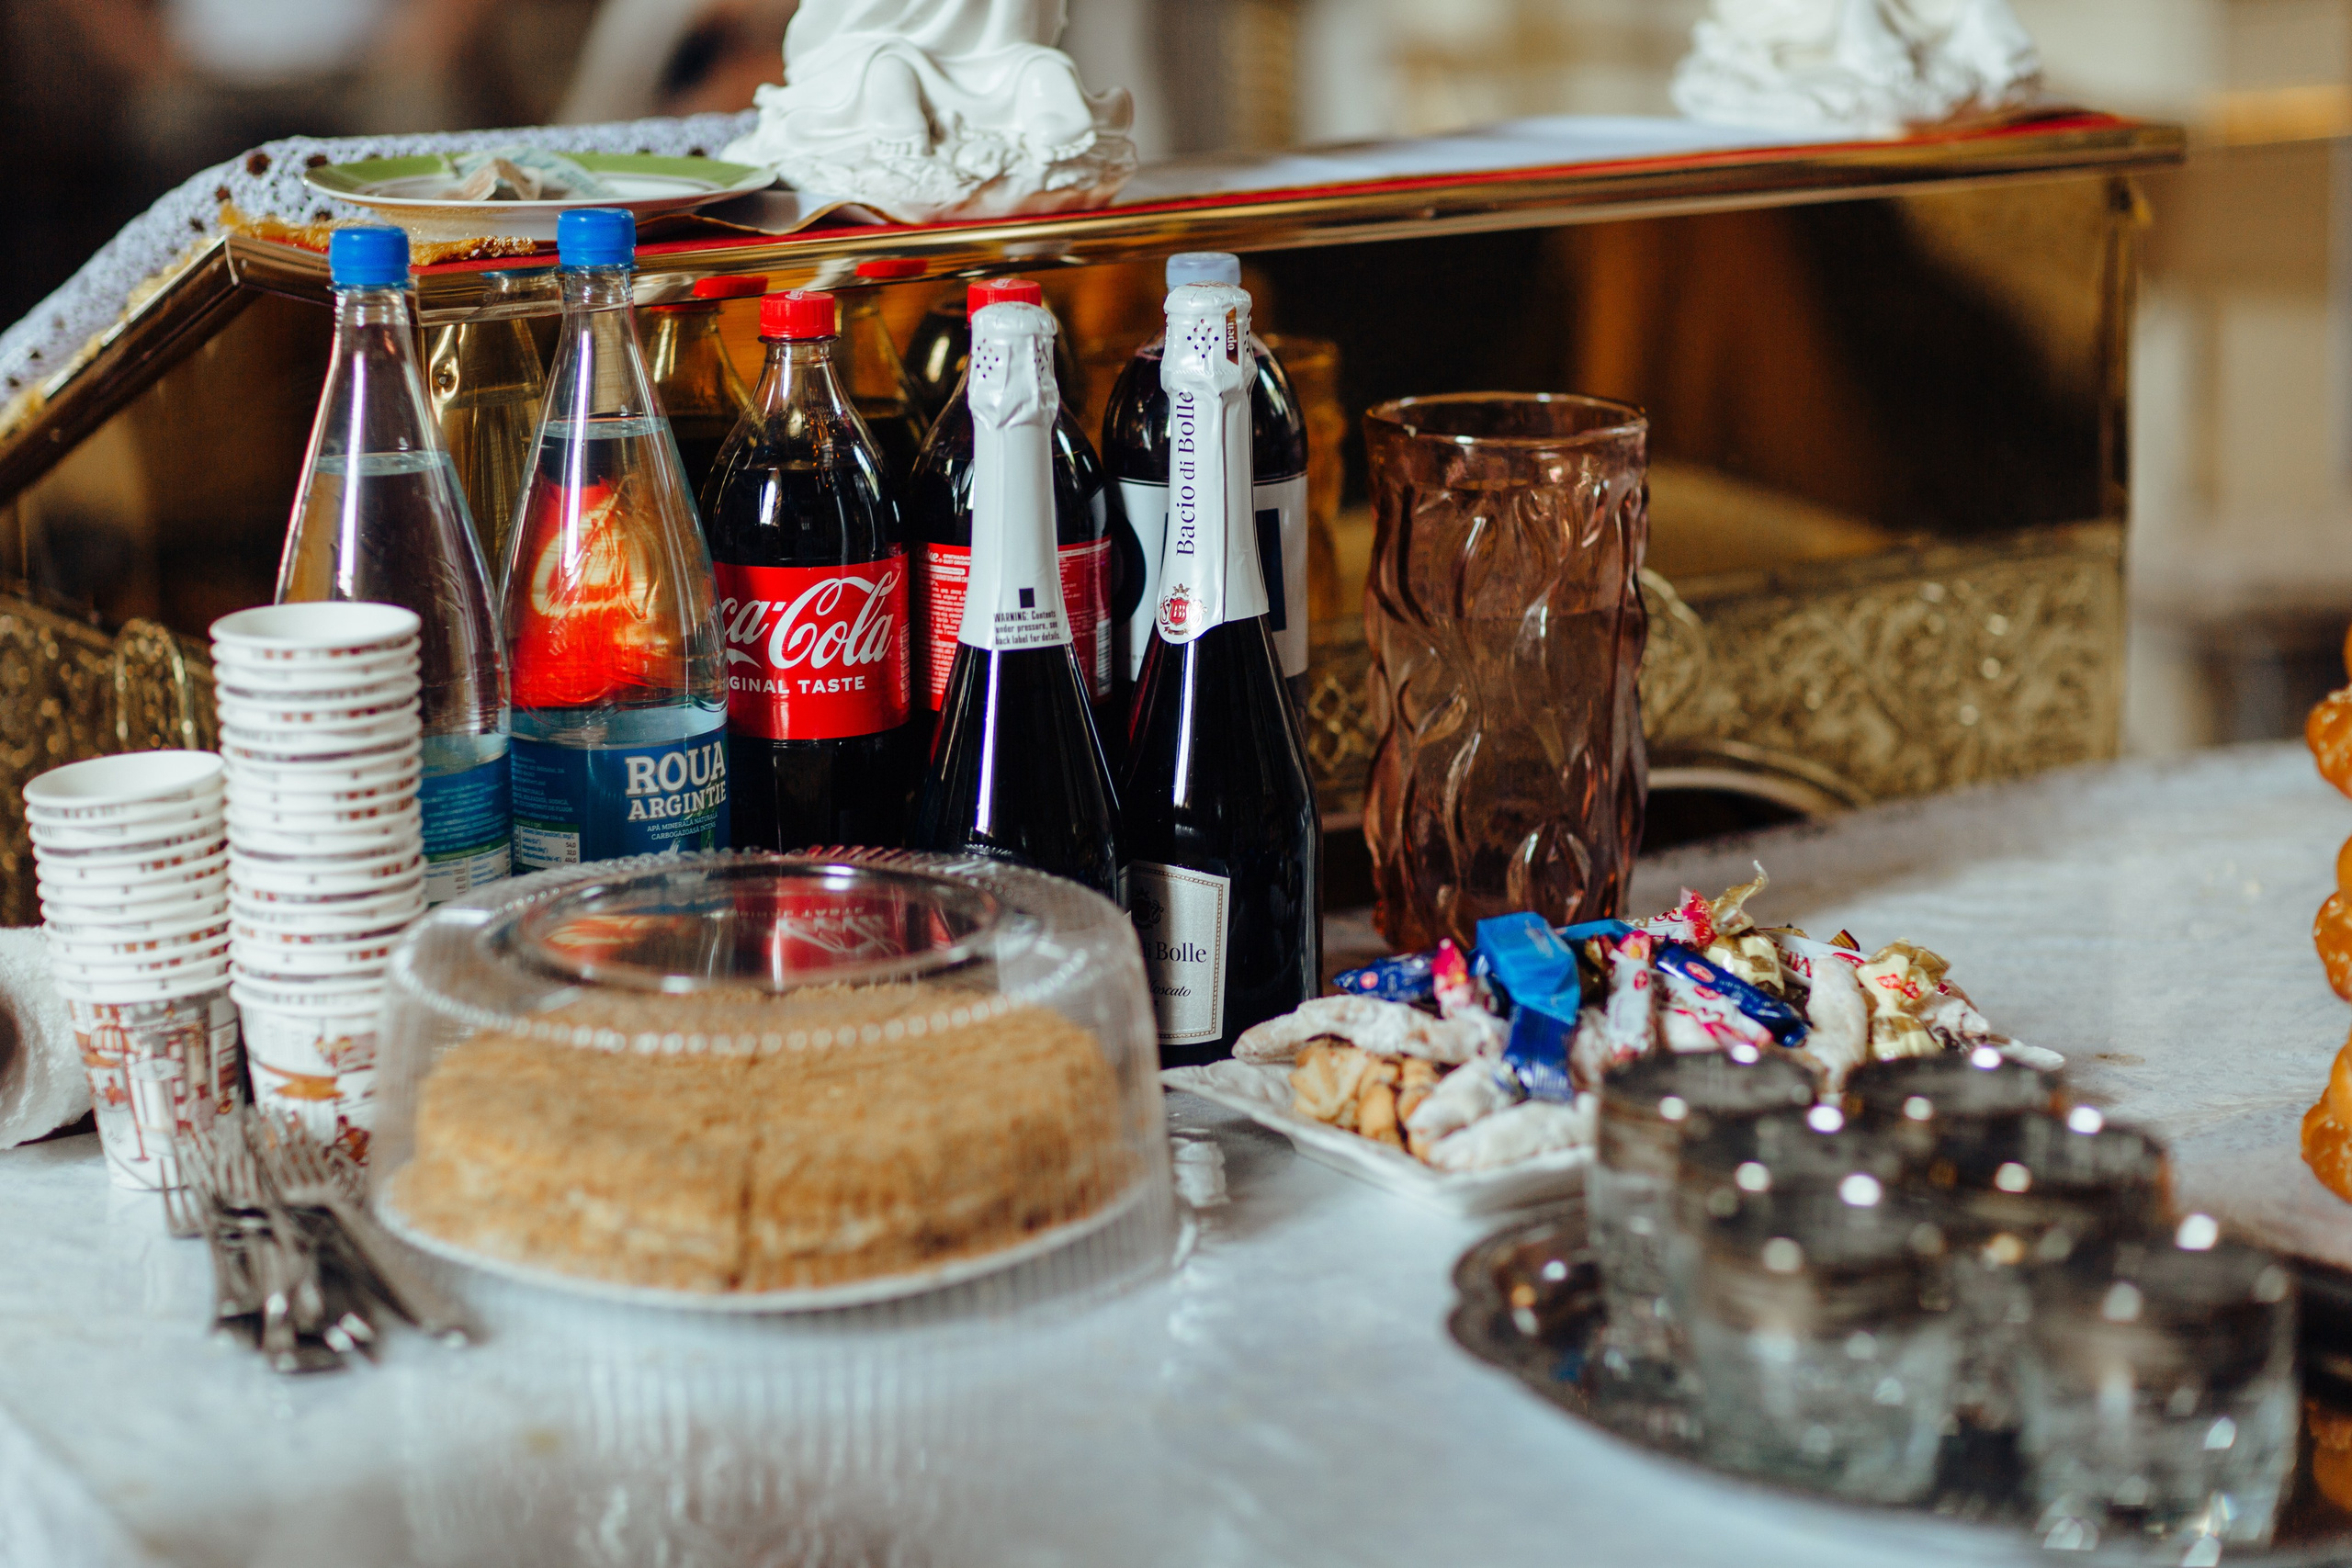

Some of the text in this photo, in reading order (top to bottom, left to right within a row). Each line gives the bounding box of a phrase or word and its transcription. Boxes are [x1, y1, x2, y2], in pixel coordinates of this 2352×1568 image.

[1227, 321, 1238, 351] open
[1176, 391, 1195, 558] Bacio di Bolle
[720, 568, 901, 670] ca-Cola
[994, 610, 1056, 623] WARNING: Contents
[995, 621, 1058, 634] under pressure, see
[995, 631, 1061, 645] back label for details.
[729, 676, 865, 694] GINAL TASTE
[625, 740, 727, 796] ROUA
[628, 780, 727, 821] ARGINTIE
[1156, 942, 1207, 964] Bolle
